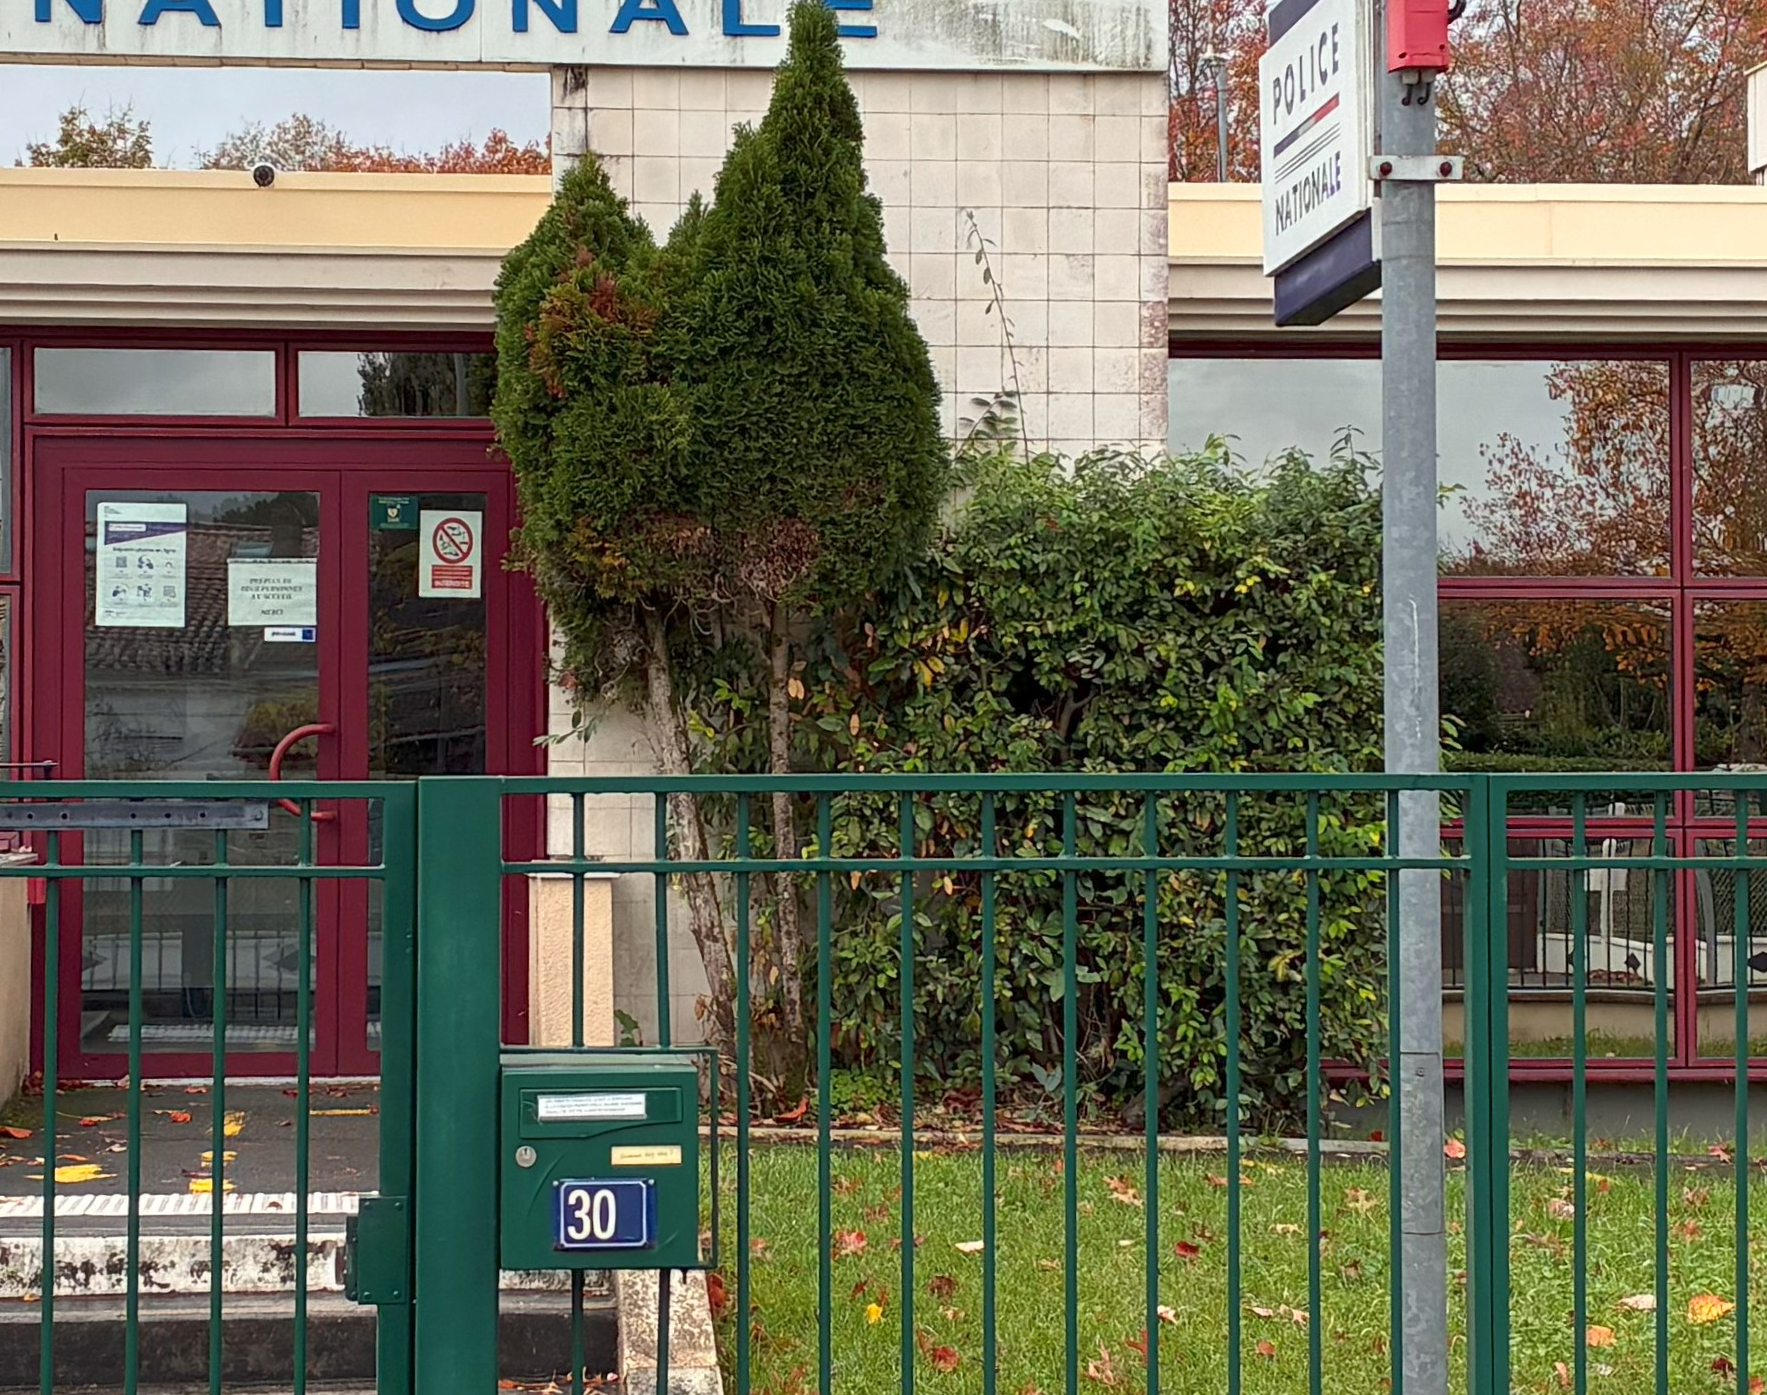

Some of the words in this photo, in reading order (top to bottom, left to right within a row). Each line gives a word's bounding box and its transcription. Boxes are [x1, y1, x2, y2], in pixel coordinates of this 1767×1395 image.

[1272, 22, 1340, 126] POLICE
[1275, 150, 1342, 236] NATIONALE
[567, 1189, 616, 1240] 30
